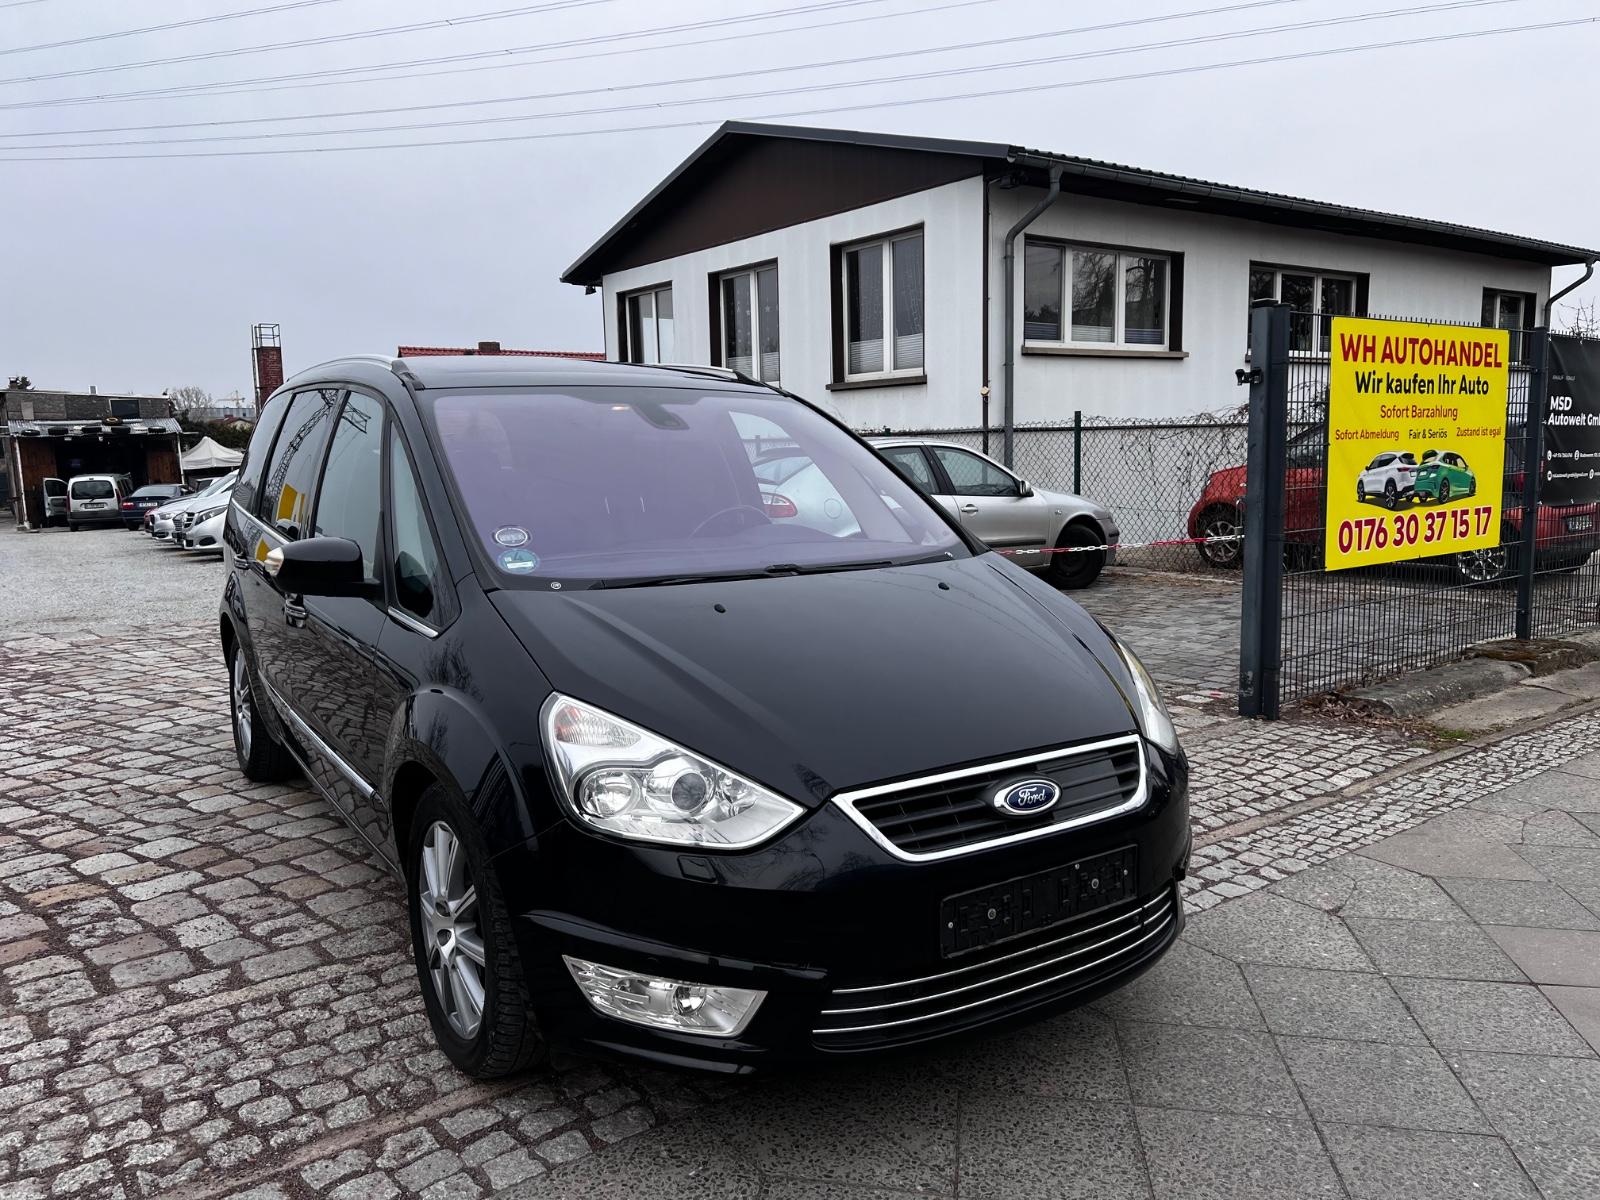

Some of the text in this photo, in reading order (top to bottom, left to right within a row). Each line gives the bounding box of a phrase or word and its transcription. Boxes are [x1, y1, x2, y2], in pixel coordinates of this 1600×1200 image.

[1340, 333, 1502, 368] WH AUTOHANDEL
[1355, 370, 1489, 395] Wir kaufen Ihr Auto
[1550, 396, 1572, 410] MSD
[1380, 405, 1458, 421] Sofort Barzahlung
[1548, 412, 1586, 425] Autowelt
[1335, 429, 1399, 441] Sofort Abmeldung
[1409, 428, 1448, 440] Fair & Seriös
[1456, 427, 1480, 437] Zustand
[1489, 426, 1501, 438] egal
[1338, 506, 1492, 553] 0176 30 37 15 17
[1018, 787, 1046, 806] Ford
